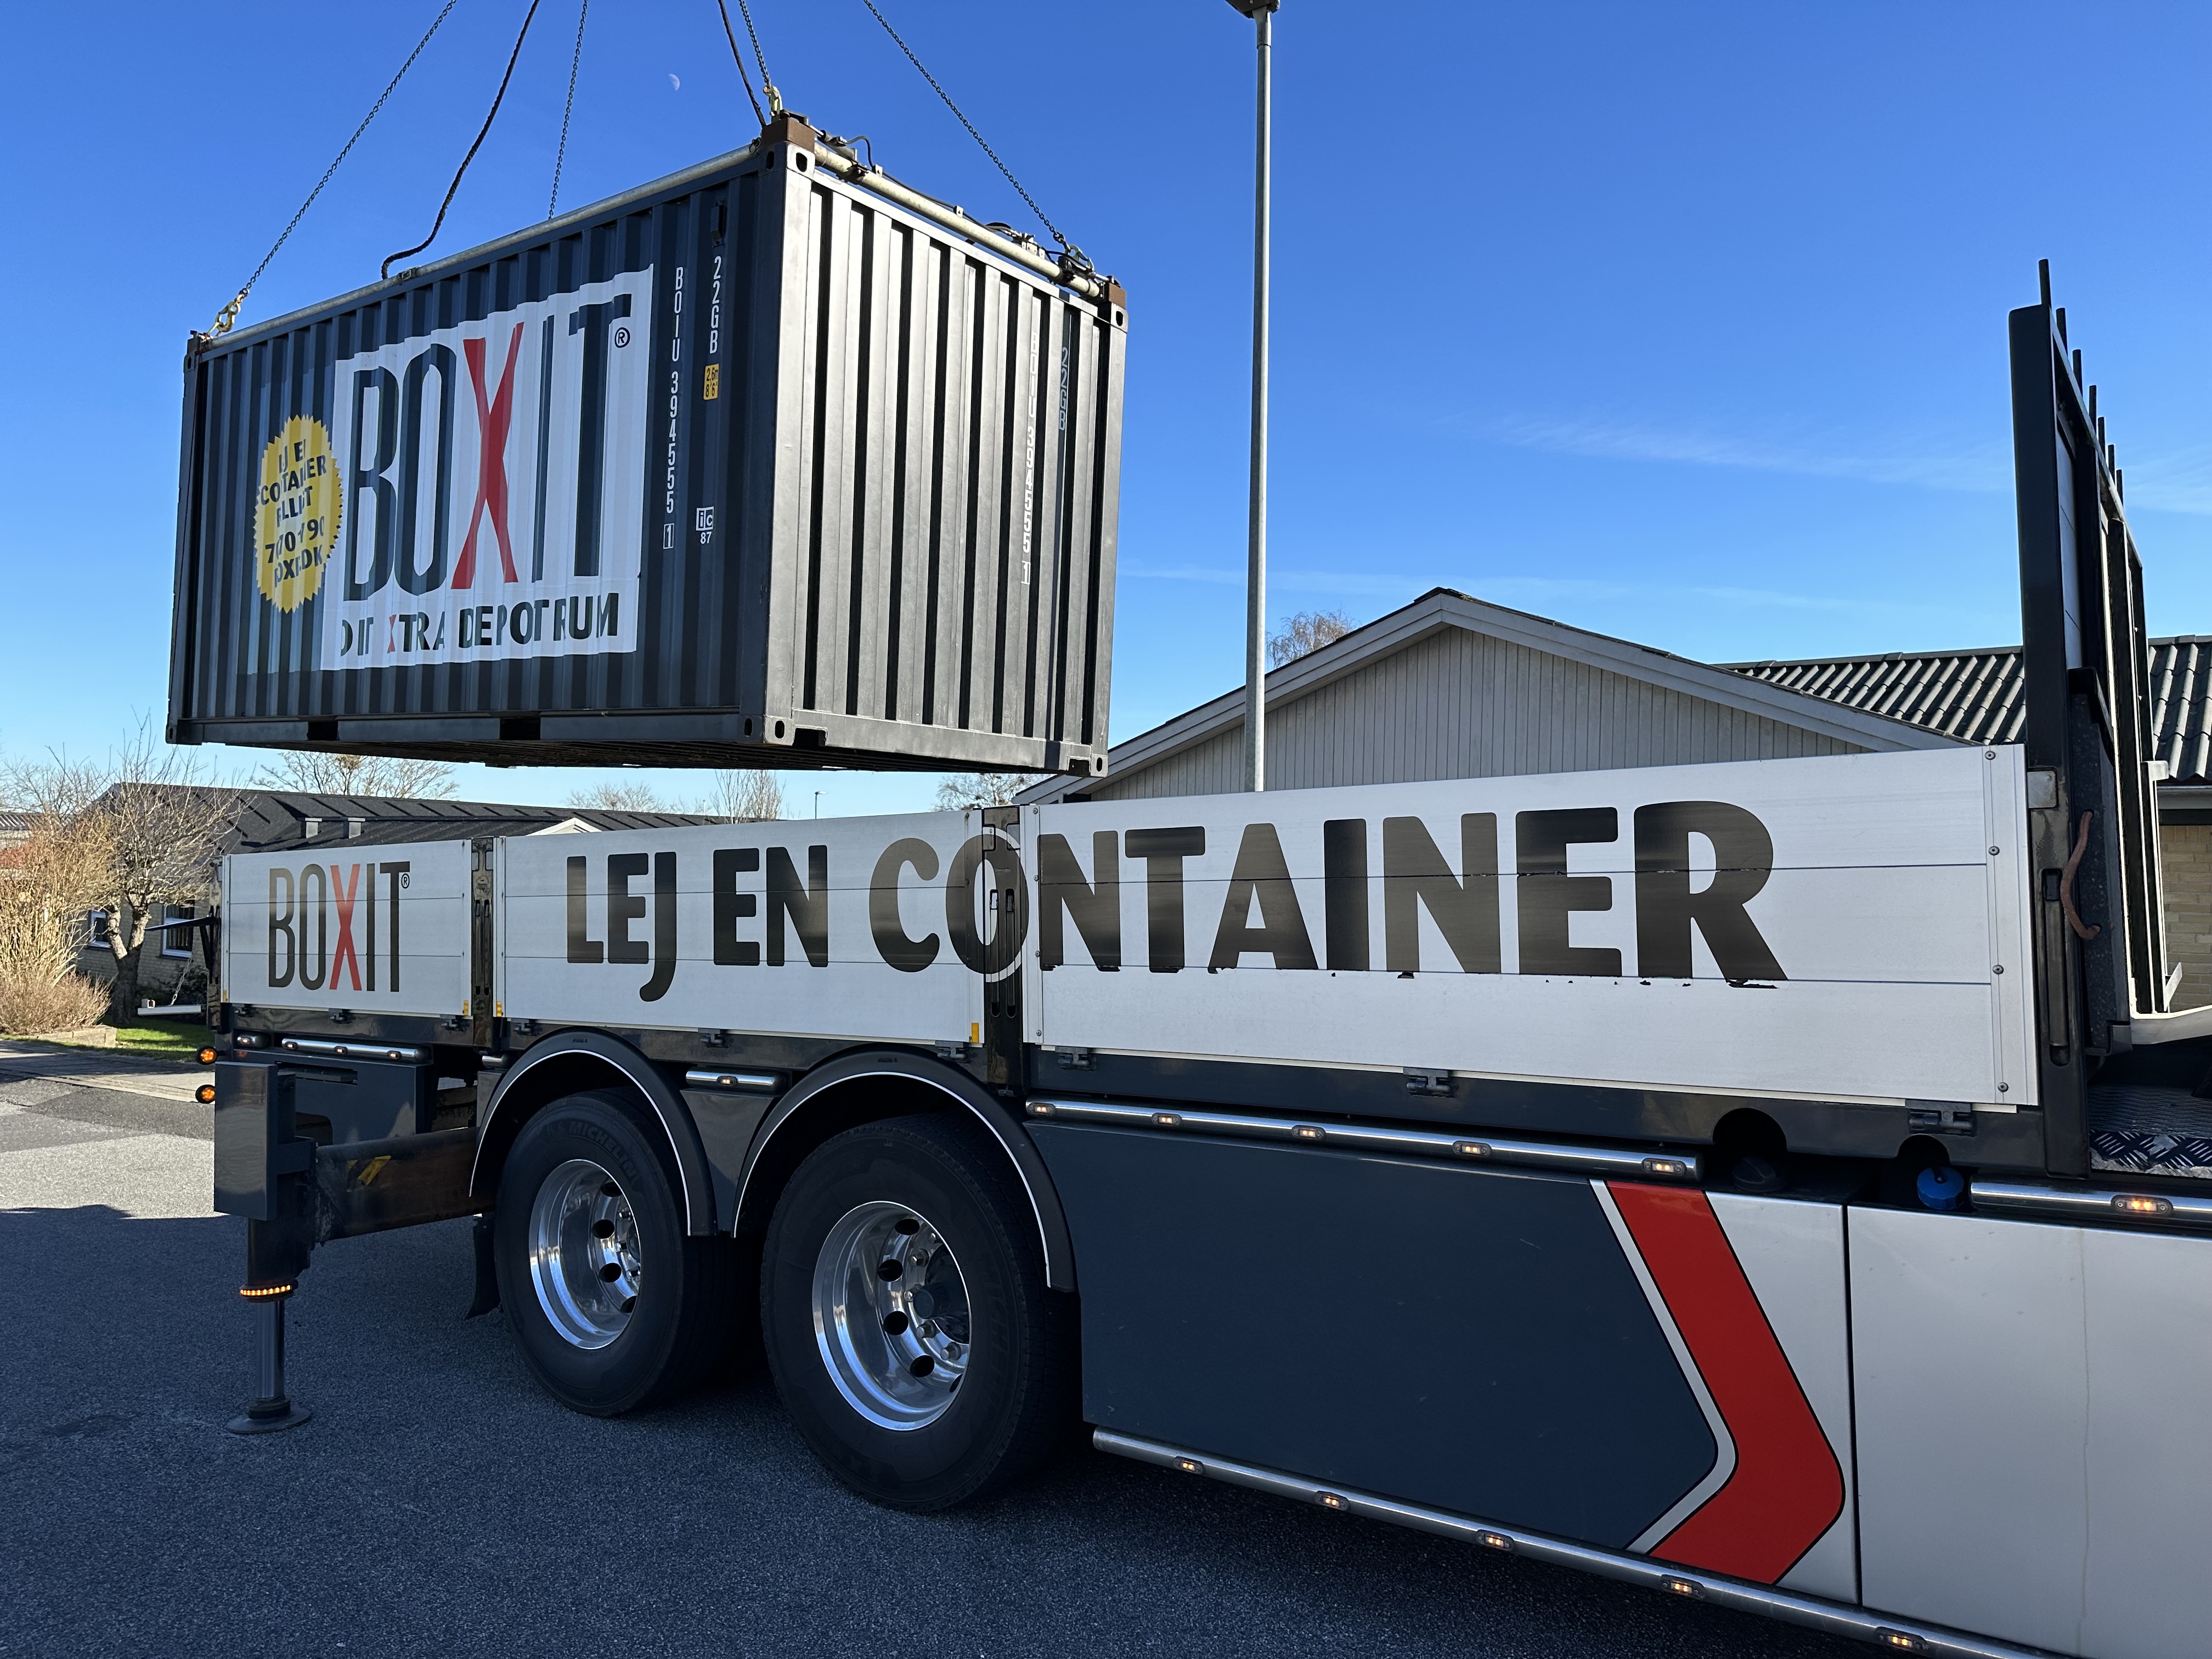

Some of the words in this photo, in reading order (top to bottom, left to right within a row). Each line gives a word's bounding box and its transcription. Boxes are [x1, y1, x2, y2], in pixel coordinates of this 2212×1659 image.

[672, 267, 684, 362] BOIU
[710, 256, 722, 354] 22GB
[1029, 331, 1039, 418] BOIU
[1059, 347, 1069, 431] 22GB
[667, 371, 679, 514] 394555
[1023, 425, 1035, 553] 394555
[700, 532, 712, 544] 87
[567, 851, 677, 1002] LEJ
[713, 845, 829, 967] EN
[869, 800, 1788, 989] CONTAINER
[568, 1121, 640, 1179] MICHELIN
